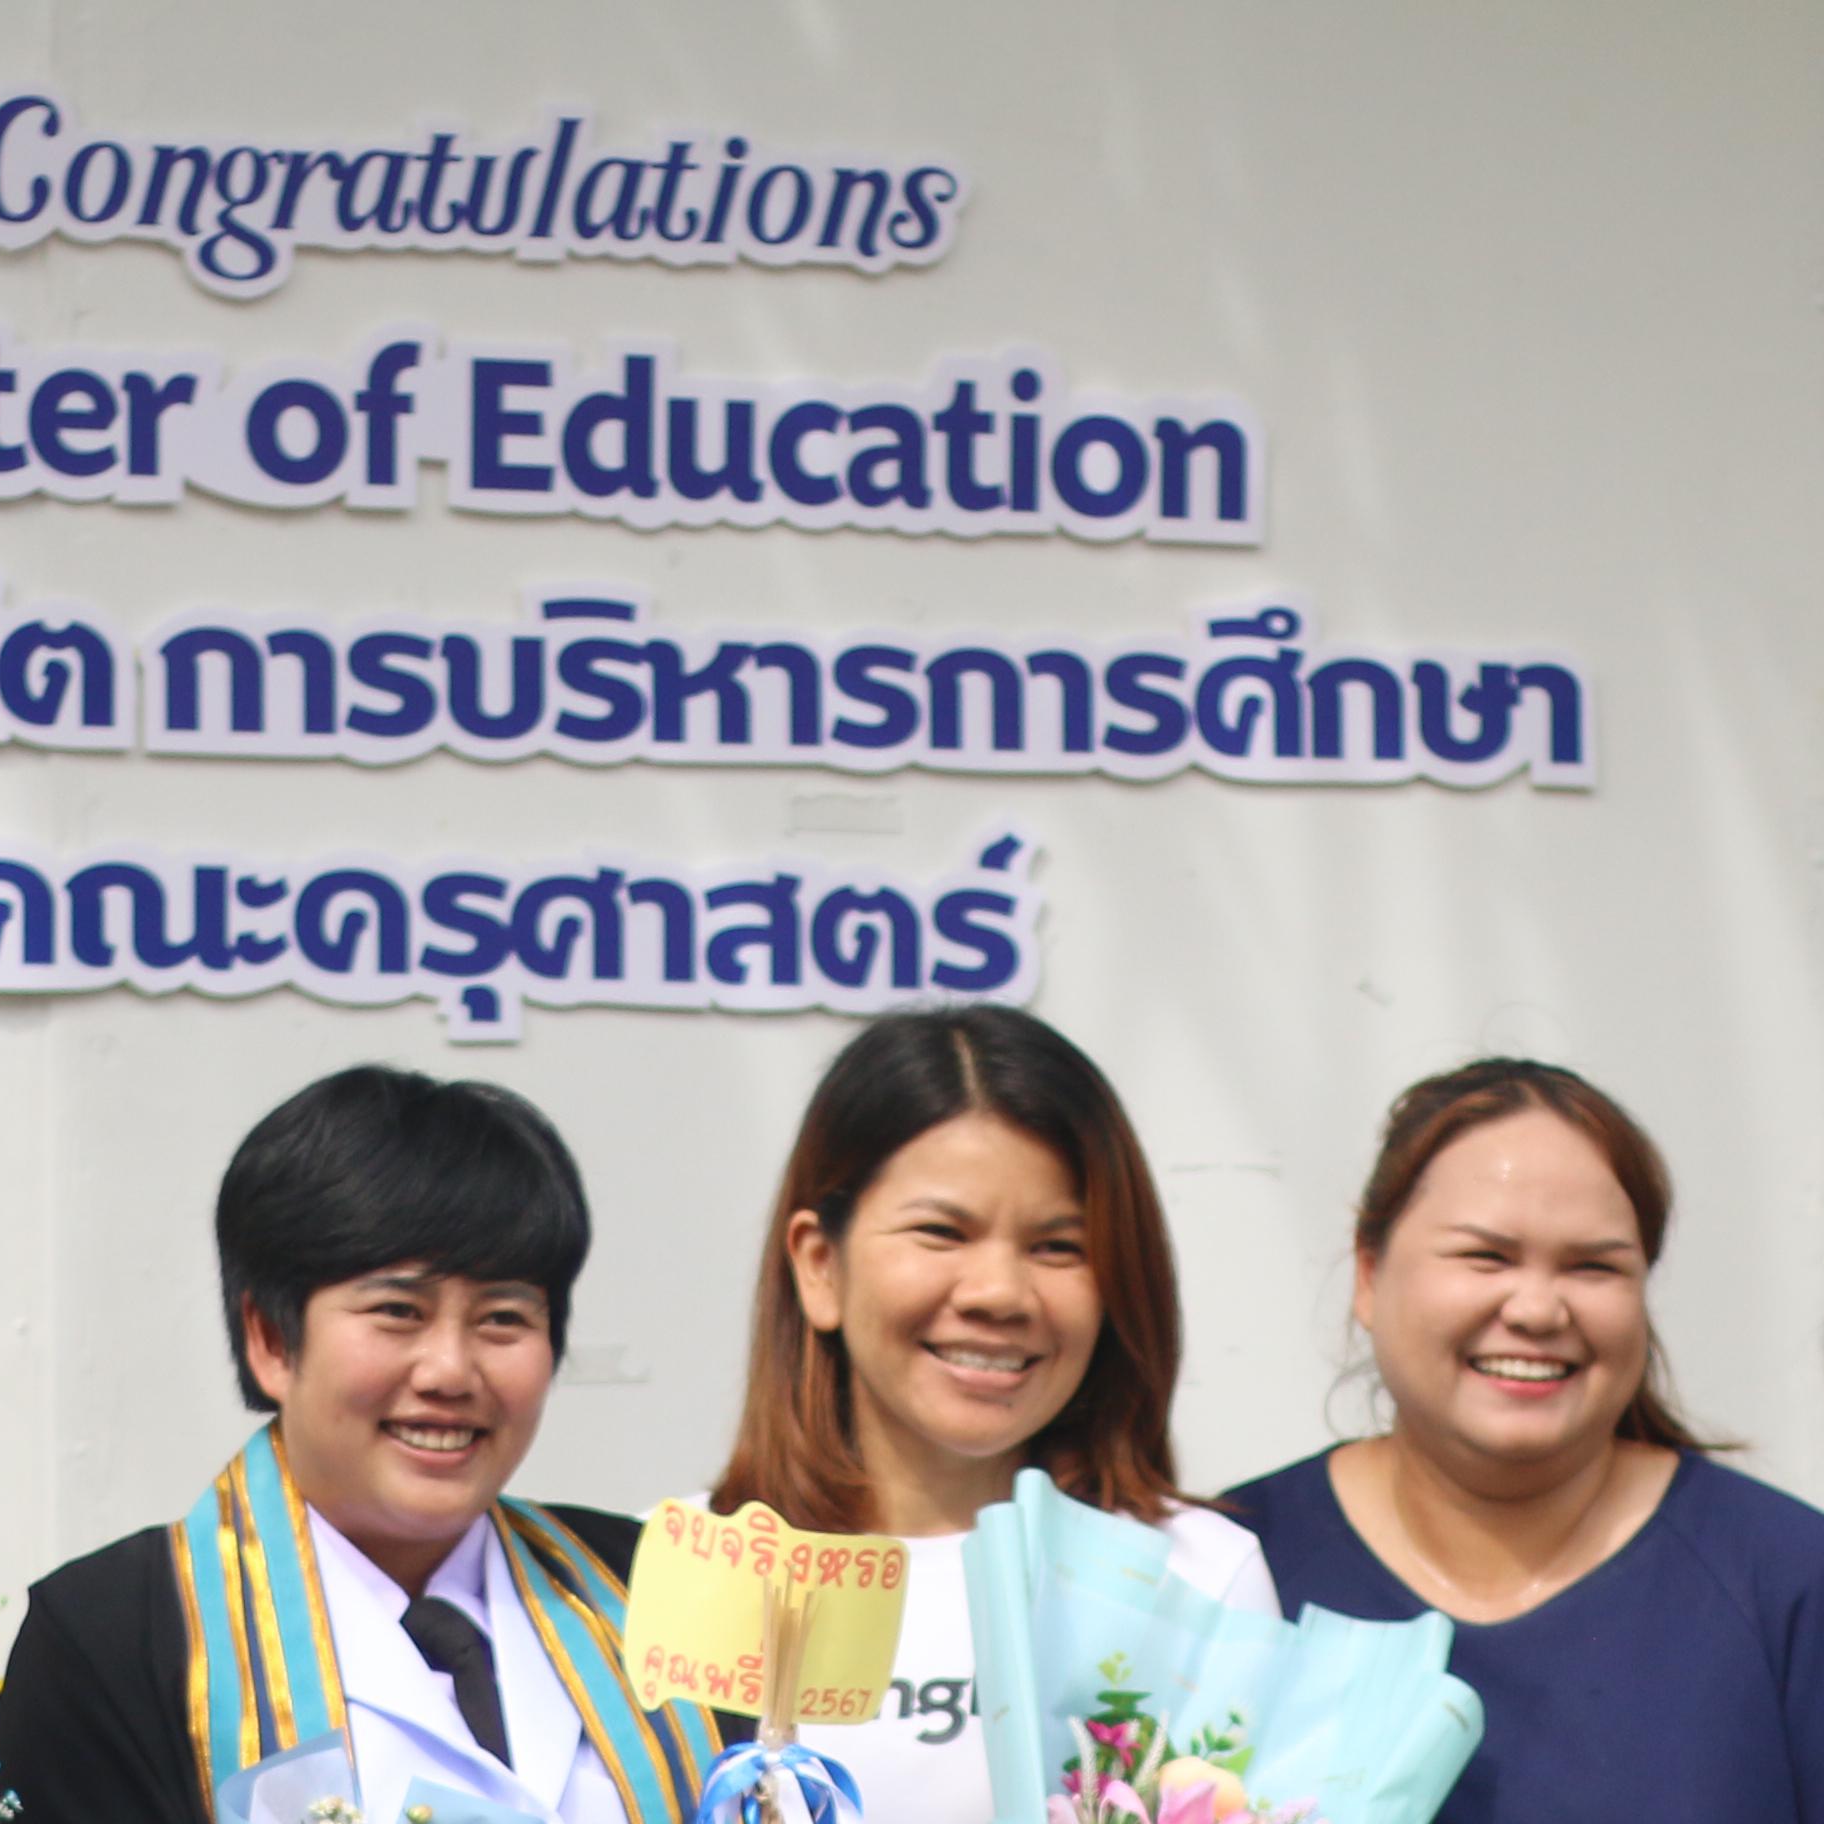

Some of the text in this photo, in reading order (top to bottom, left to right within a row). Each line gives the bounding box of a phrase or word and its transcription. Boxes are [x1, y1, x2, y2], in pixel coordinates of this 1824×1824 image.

[244, 340, 421, 486] of
[469, 353, 1247, 522] Education
[158, 597, 1583, 765] การบริหารการศึกษา
[799, 1687, 873, 1717] 2567
